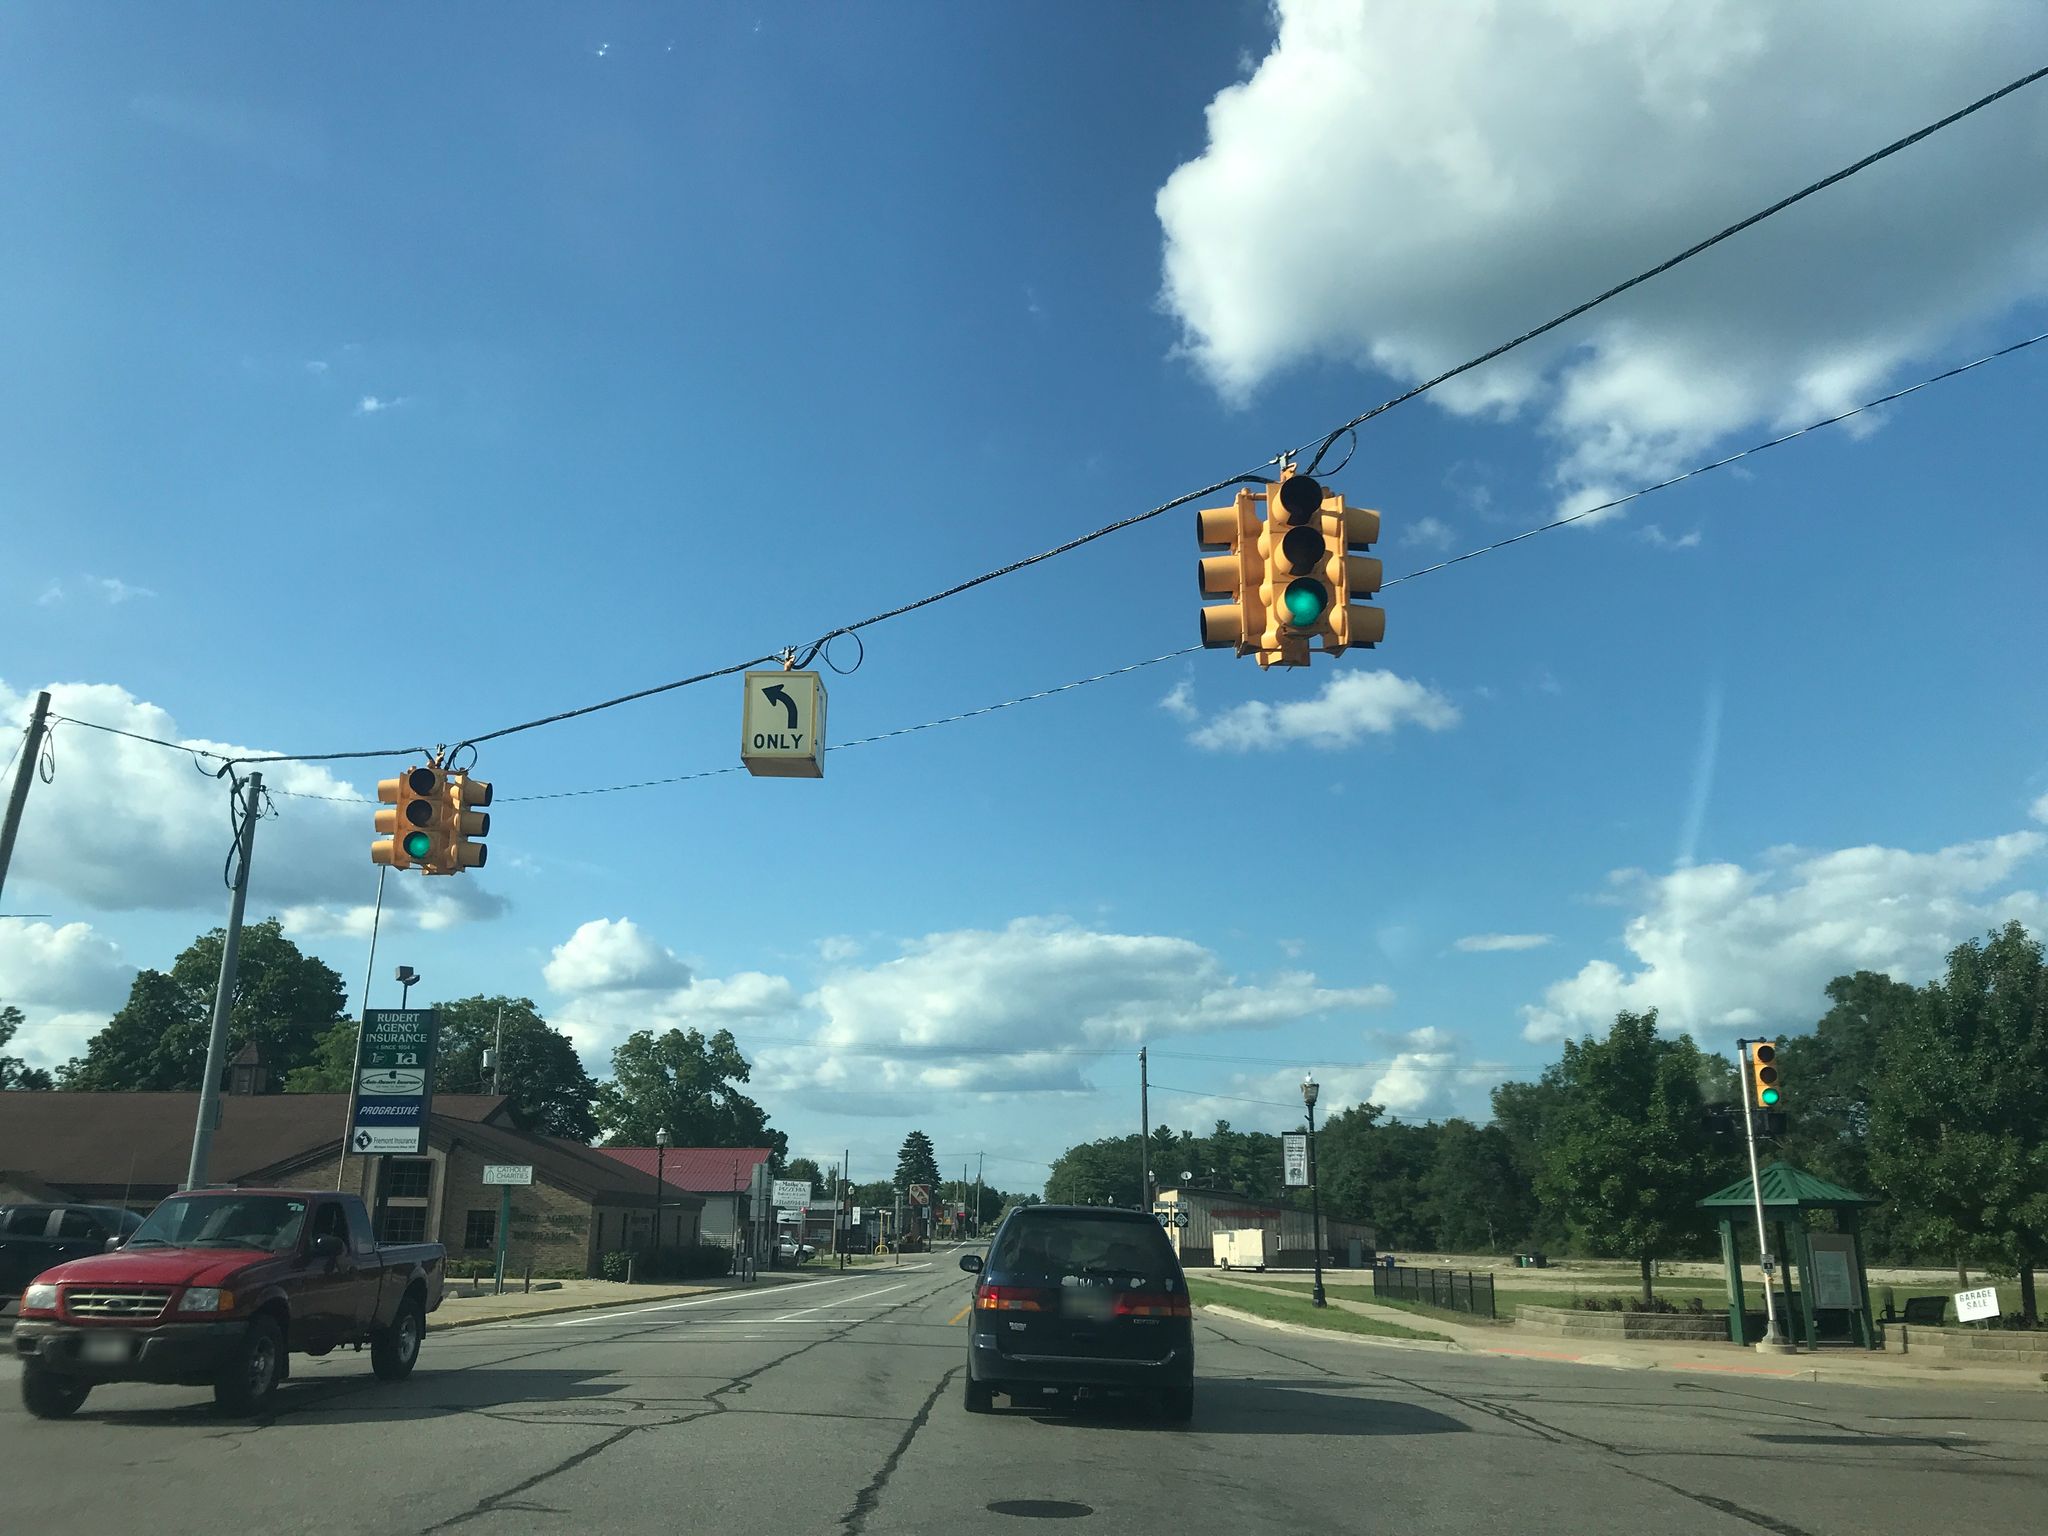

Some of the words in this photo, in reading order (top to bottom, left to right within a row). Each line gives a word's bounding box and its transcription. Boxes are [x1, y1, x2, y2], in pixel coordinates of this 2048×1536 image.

[753, 733, 804, 750] ONLY
[377, 1013, 420, 1023] RUDERT
[375, 1023, 420, 1033] AGENCY
[366, 1033, 428, 1043] INSURANCE
[360, 1106, 420, 1115] PROGRESSIVE
[373, 1137, 394, 1145] Fremont
[394, 1137, 417, 1145] Insurance
[911, 1185, 928, 1204] GAS
[1177, 1217, 1186, 1225] 20
[1959, 1289, 1992, 1303] GARAGE
[1966, 1299, 1988, 1308] SALE
